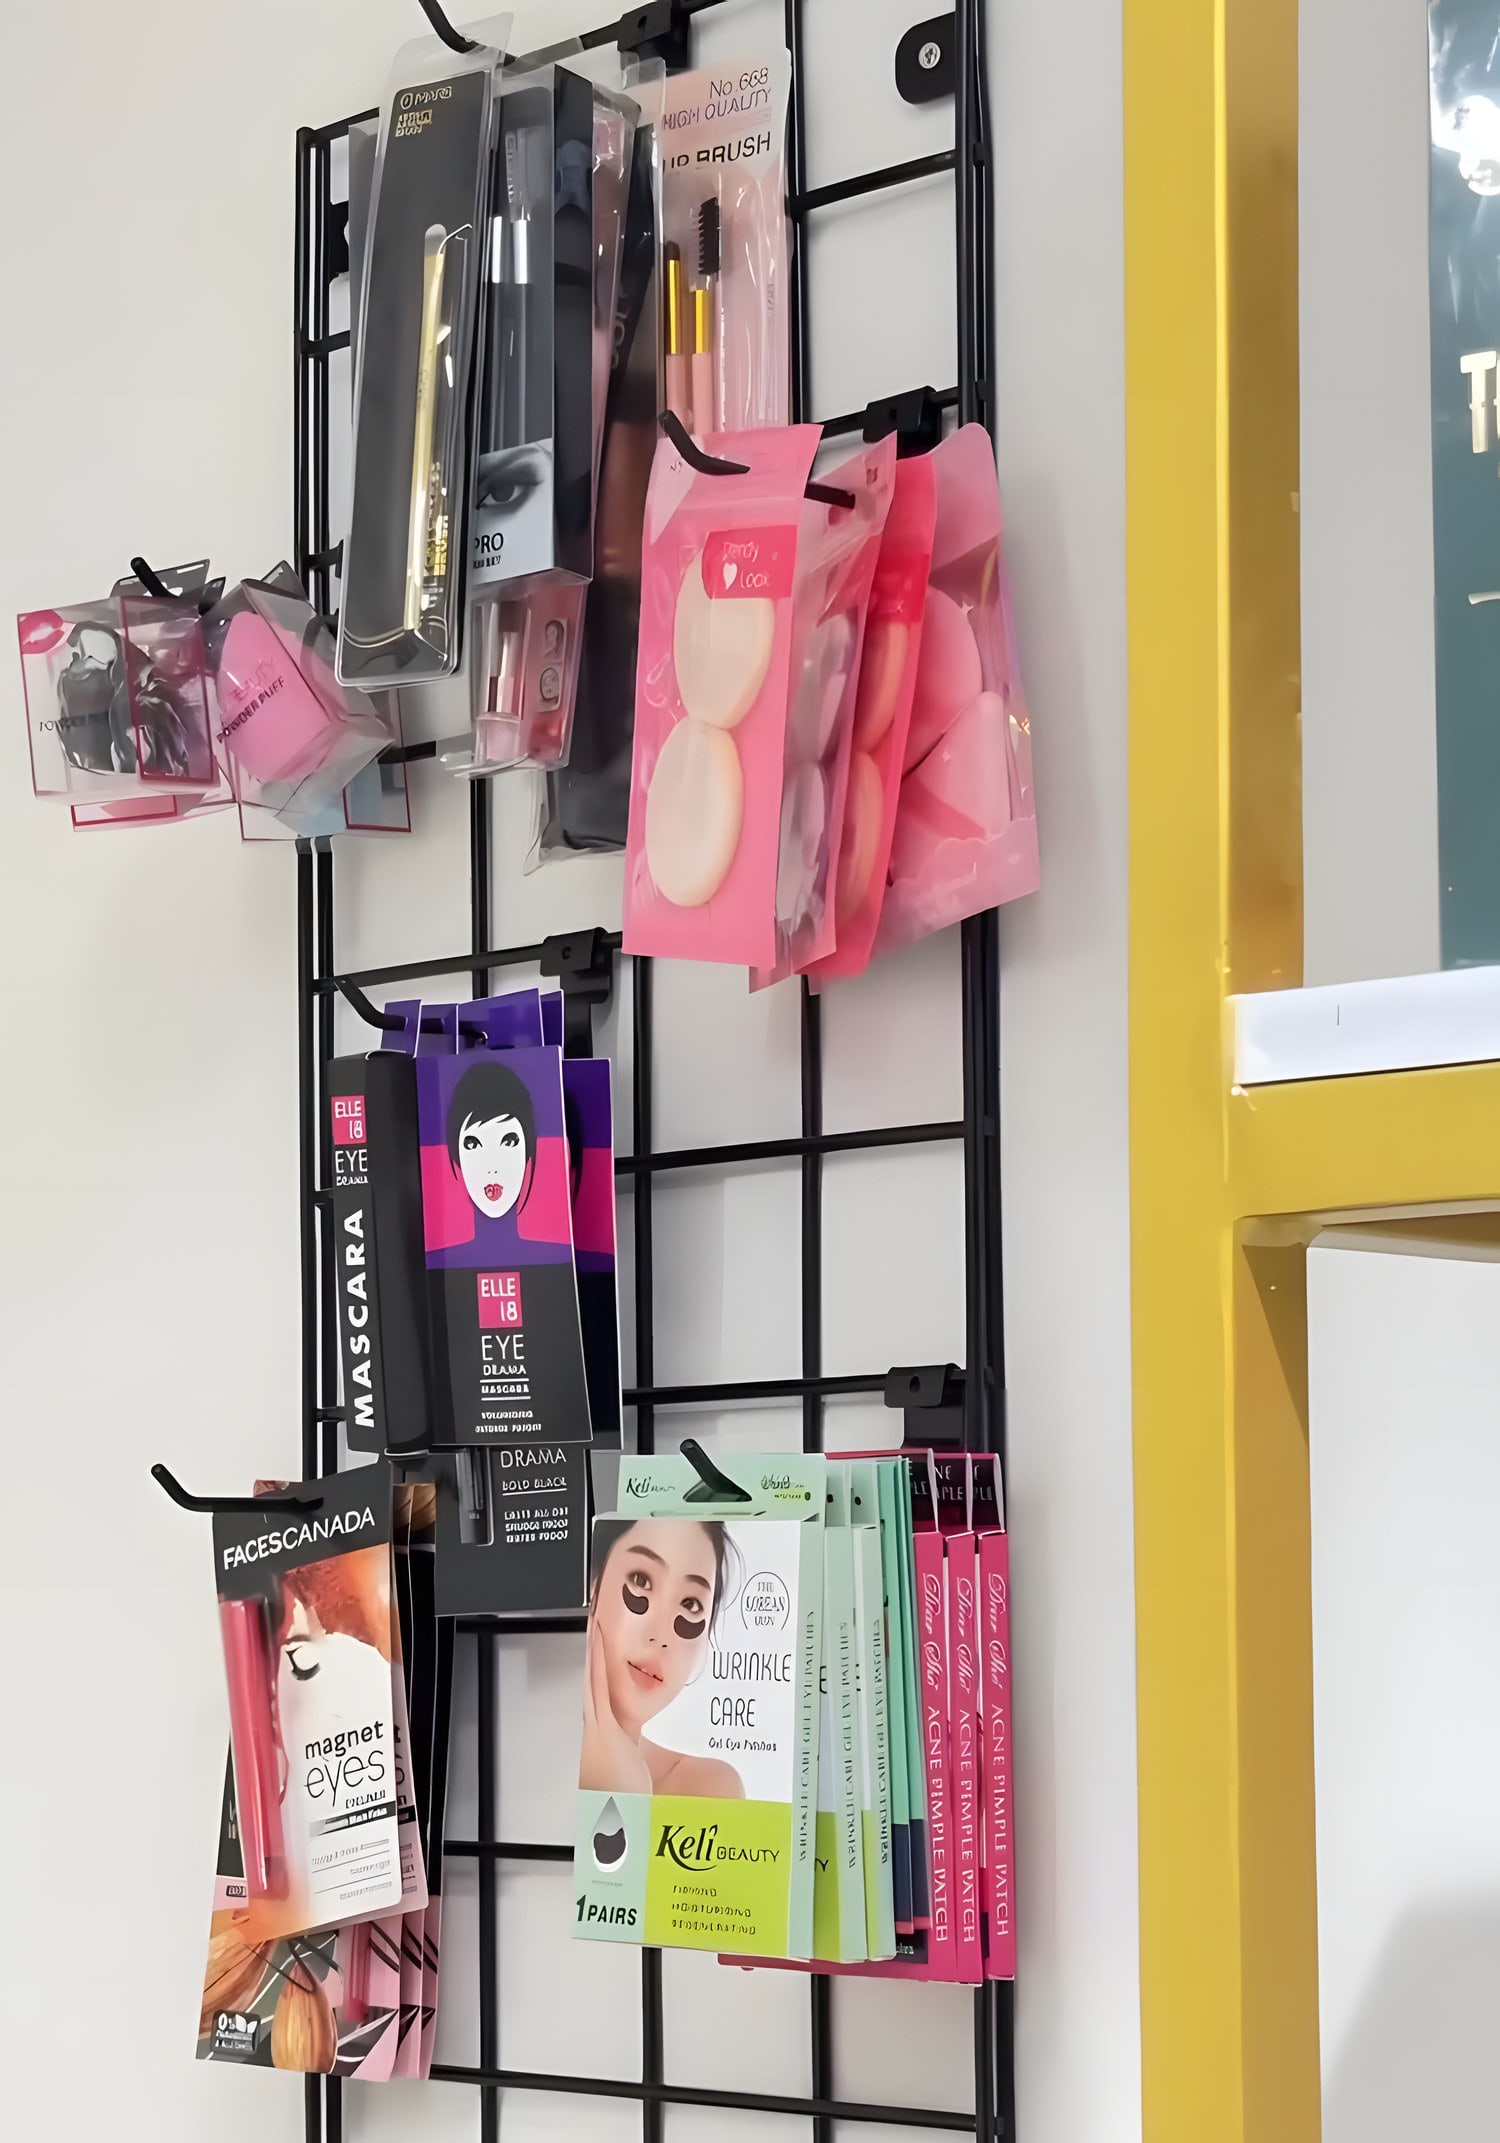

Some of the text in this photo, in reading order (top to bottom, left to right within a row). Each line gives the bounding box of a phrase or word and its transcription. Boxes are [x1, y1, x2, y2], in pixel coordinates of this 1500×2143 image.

[696, 131, 771, 164] BRUSH
[1460, 350, 1500, 454] T
[474, 532, 504, 554] PRO
[335, 1100, 362, 1118] ELLE
[349, 1120, 363, 1139] 18
[335, 1148, 368, 1174] EYE
[481, 1277, 516, 1297] ELLE
[343, 1209, 376, 1428] MASCARA
[500, 1301, 518, 1321] 18
[481, 1334, 525, 1361] EYE
[500, 1447, 567, 1468] DRAMA
[712, 1651, 792, 1682] WRINKLE
[710, 1696, 756, 1727] CARE
[305, 1720, 384, 1760] magnet
[927, 1706, 943, 1770] ACNE
[959, 1709, 972, 1772] ACNE
[991, 1703, 1005, 1766] ACNE
[304, 1749, 386, 1807] eyes
[930, 1778, 945, 1863] PIMPLE
[960, 1780, 973, 1860] PIMPLE
[993, 1775, 1007, 1853] PIMPLE
[716, 1845, 780, 1863] BEAUTY
[933, 1868, 948, 1941] PATCH
[962, 1869, 976, 1942] PATCH
[995, 1864, 1009, 1936] PATCH
